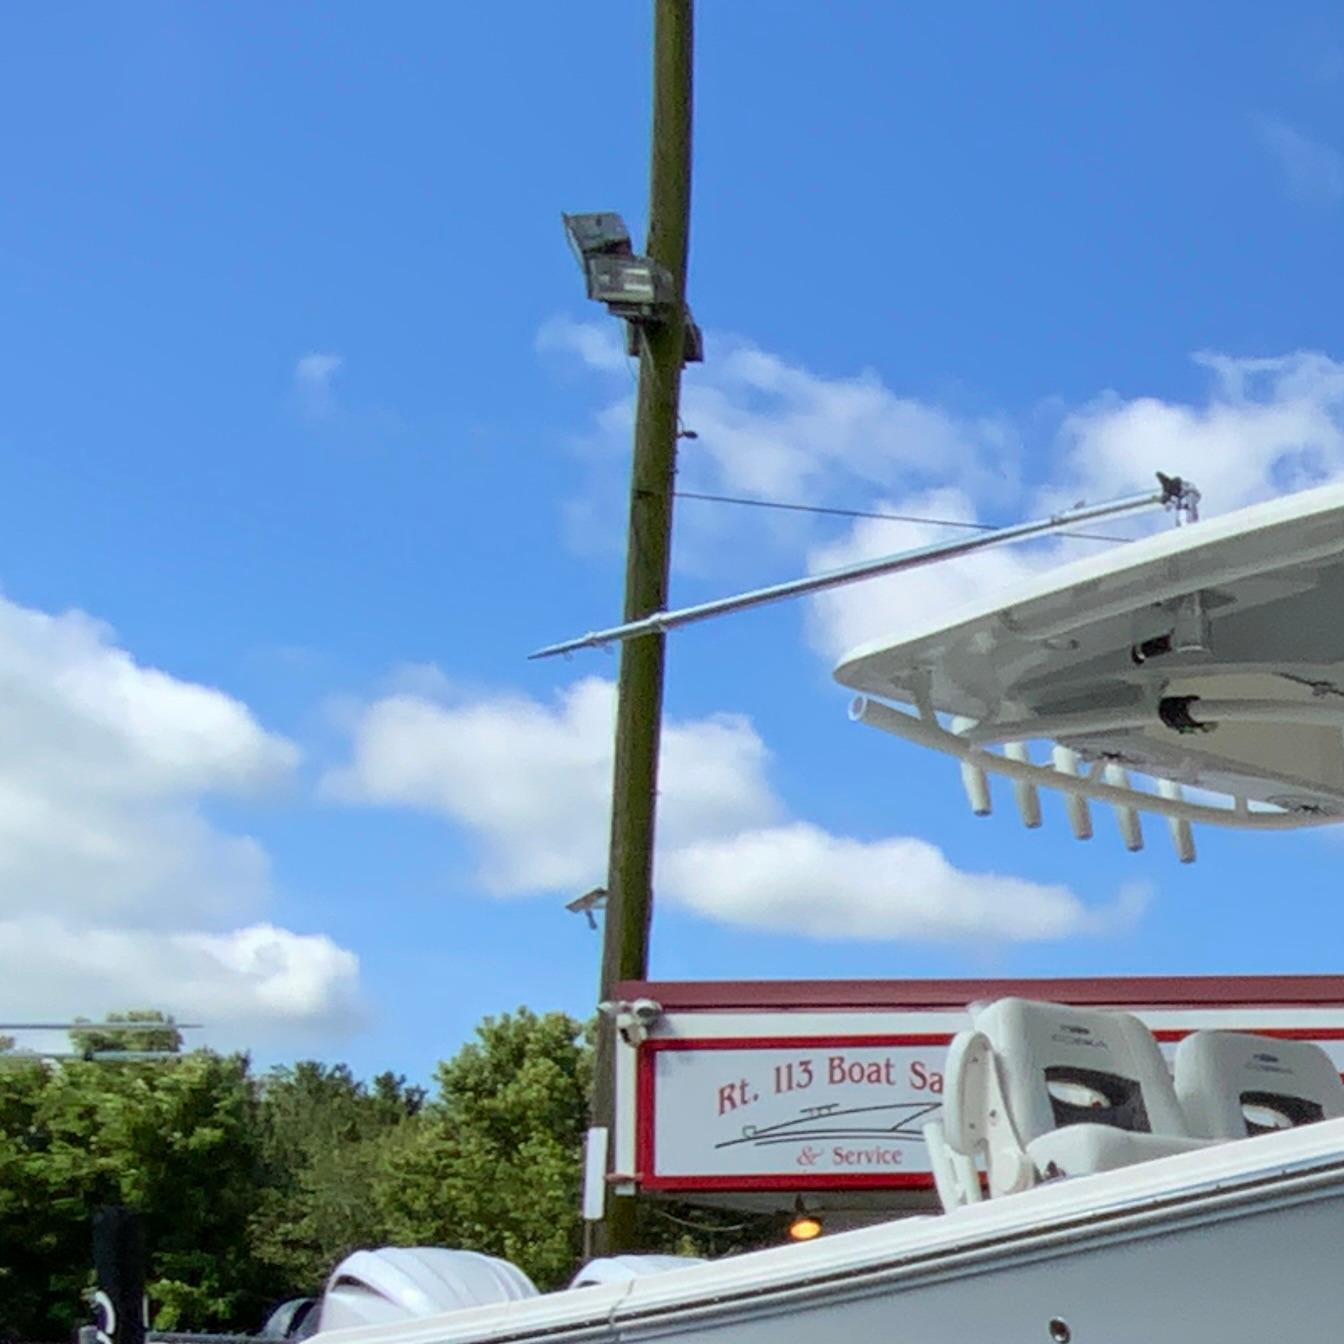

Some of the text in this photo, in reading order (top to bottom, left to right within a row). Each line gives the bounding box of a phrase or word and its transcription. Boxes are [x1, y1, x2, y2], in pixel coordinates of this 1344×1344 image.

[718, 1056, 944, 1116] Rt. 113 Boat Sa
[796, 1146, 903, 1166] & Service
